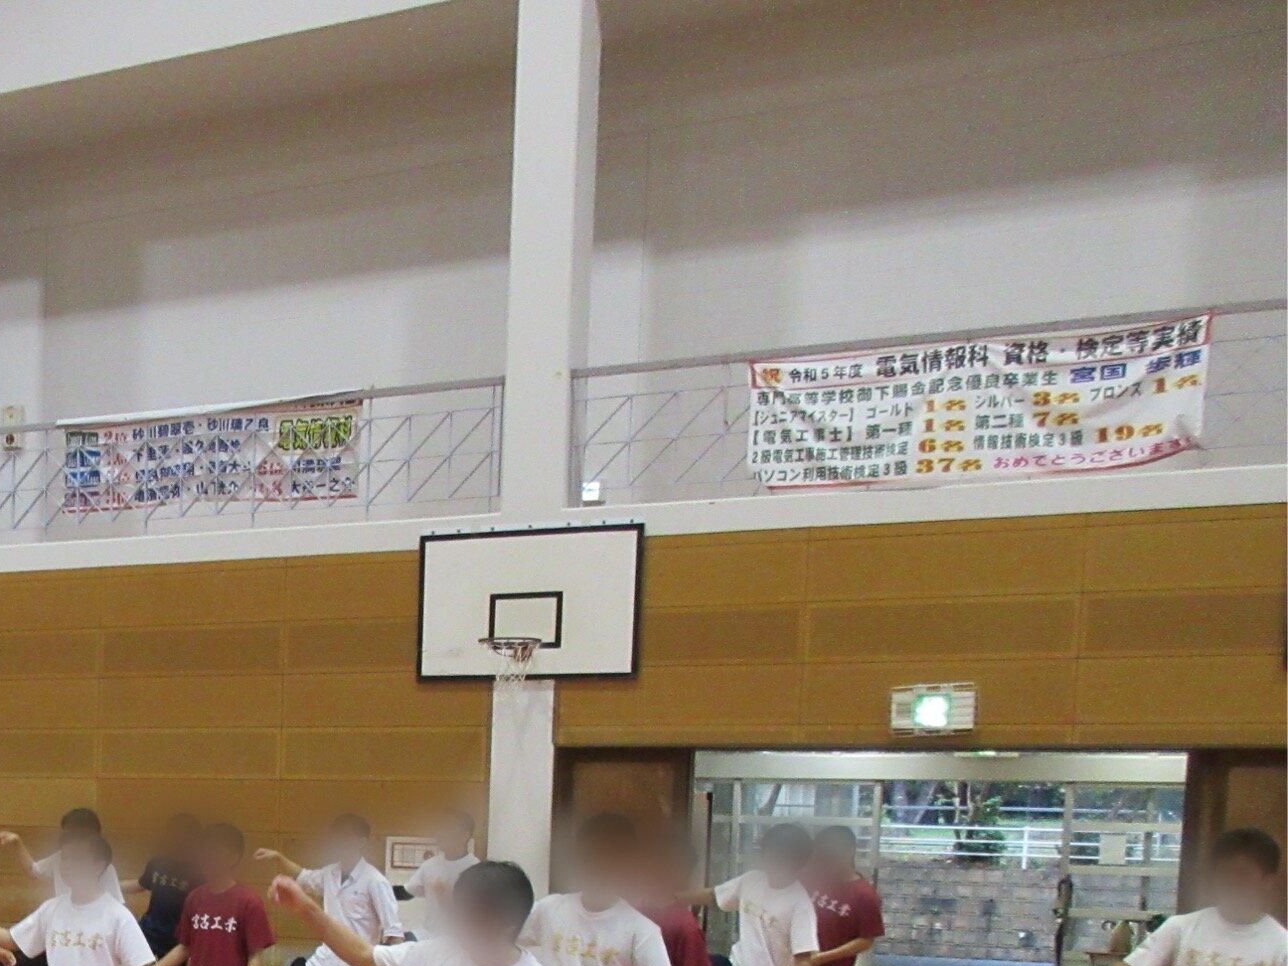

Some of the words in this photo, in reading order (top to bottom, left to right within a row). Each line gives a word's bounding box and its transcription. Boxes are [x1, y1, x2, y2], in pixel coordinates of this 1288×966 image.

[762, 368, 782, 384] 祝
[876, 345, 989, 378] 電気情報科
[1032, 390, 1080, 407] 3名
[1032, 411, 1080, 428] 7名
[918, 438, 964, 453] 6名
[1095, 422, 1164, 444] 19名
[915, 458, 983, 474] 37名
[191, 912, 238, 934] 宮古工業
[48, 929, 103, 951] 宮古工業
[551, 931, 620, 966] 宮古工業
